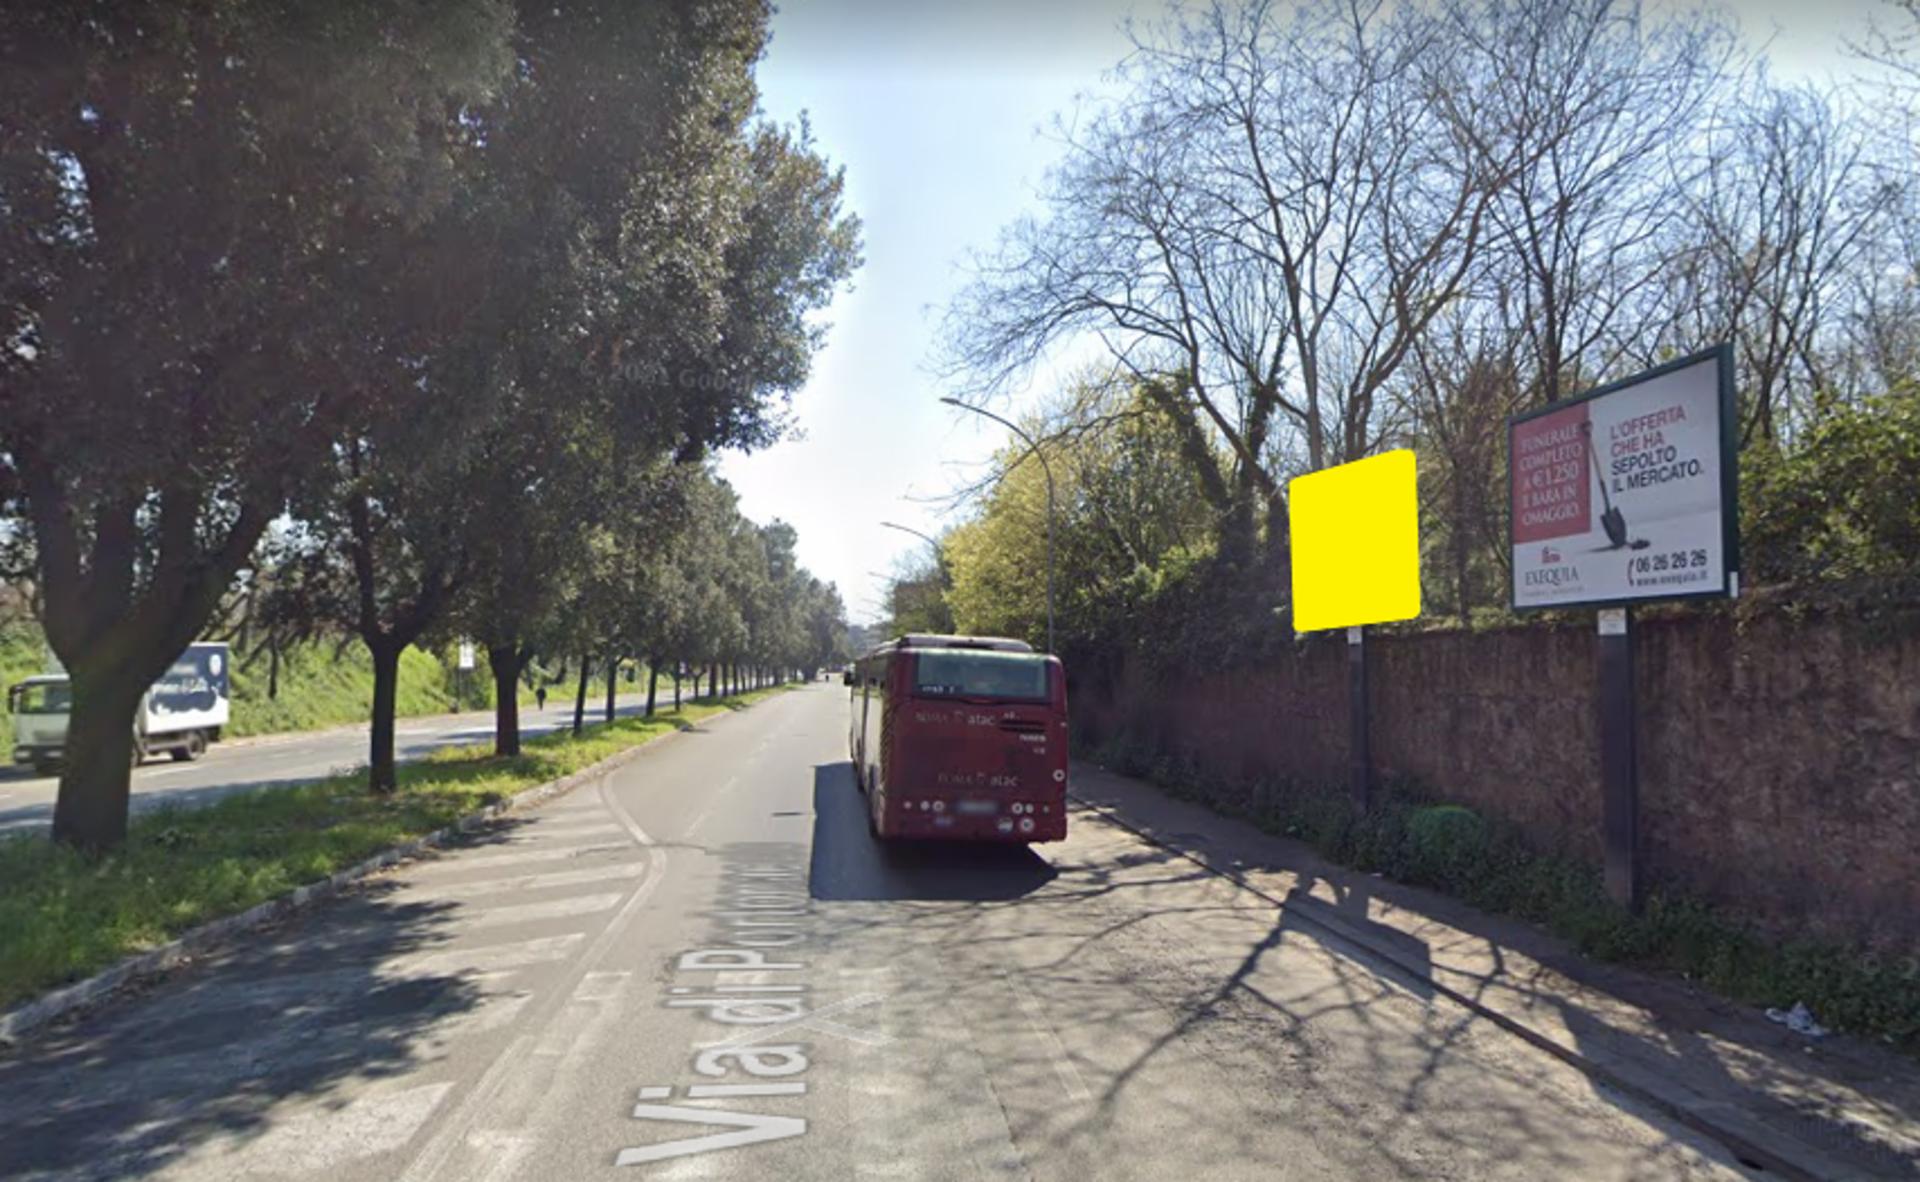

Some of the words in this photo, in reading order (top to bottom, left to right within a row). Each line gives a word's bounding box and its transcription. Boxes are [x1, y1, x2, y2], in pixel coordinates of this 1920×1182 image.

[1610, 404, 1687, 440] L'OFFERTA
[1519, 441, 1583, 471] COMPLETO
[1610, 436, 1640, 458] CHE
[1643, 430, 1665, 449] HA
[1611, 445, 1677, 476] SEPOLTO
[1612, 478, 1625, 493] IL
[1627, 458, 1705, 490] MERCATO.
[1563, 482, 1577, 500] IN
[1522, 501, 1579, 525] OMAGGIO
[1636, 556, 1650, 573] 06
[1653, 553, 1669, 571] 26
[1671, 551, 1688, 569] 26
[1690, 548, 1707, 567] 26
[1525, 566, 1579, 586] EXEQUIA
[967, 713, 996, 726] atac
[990, 773, 1019, 787] atac
